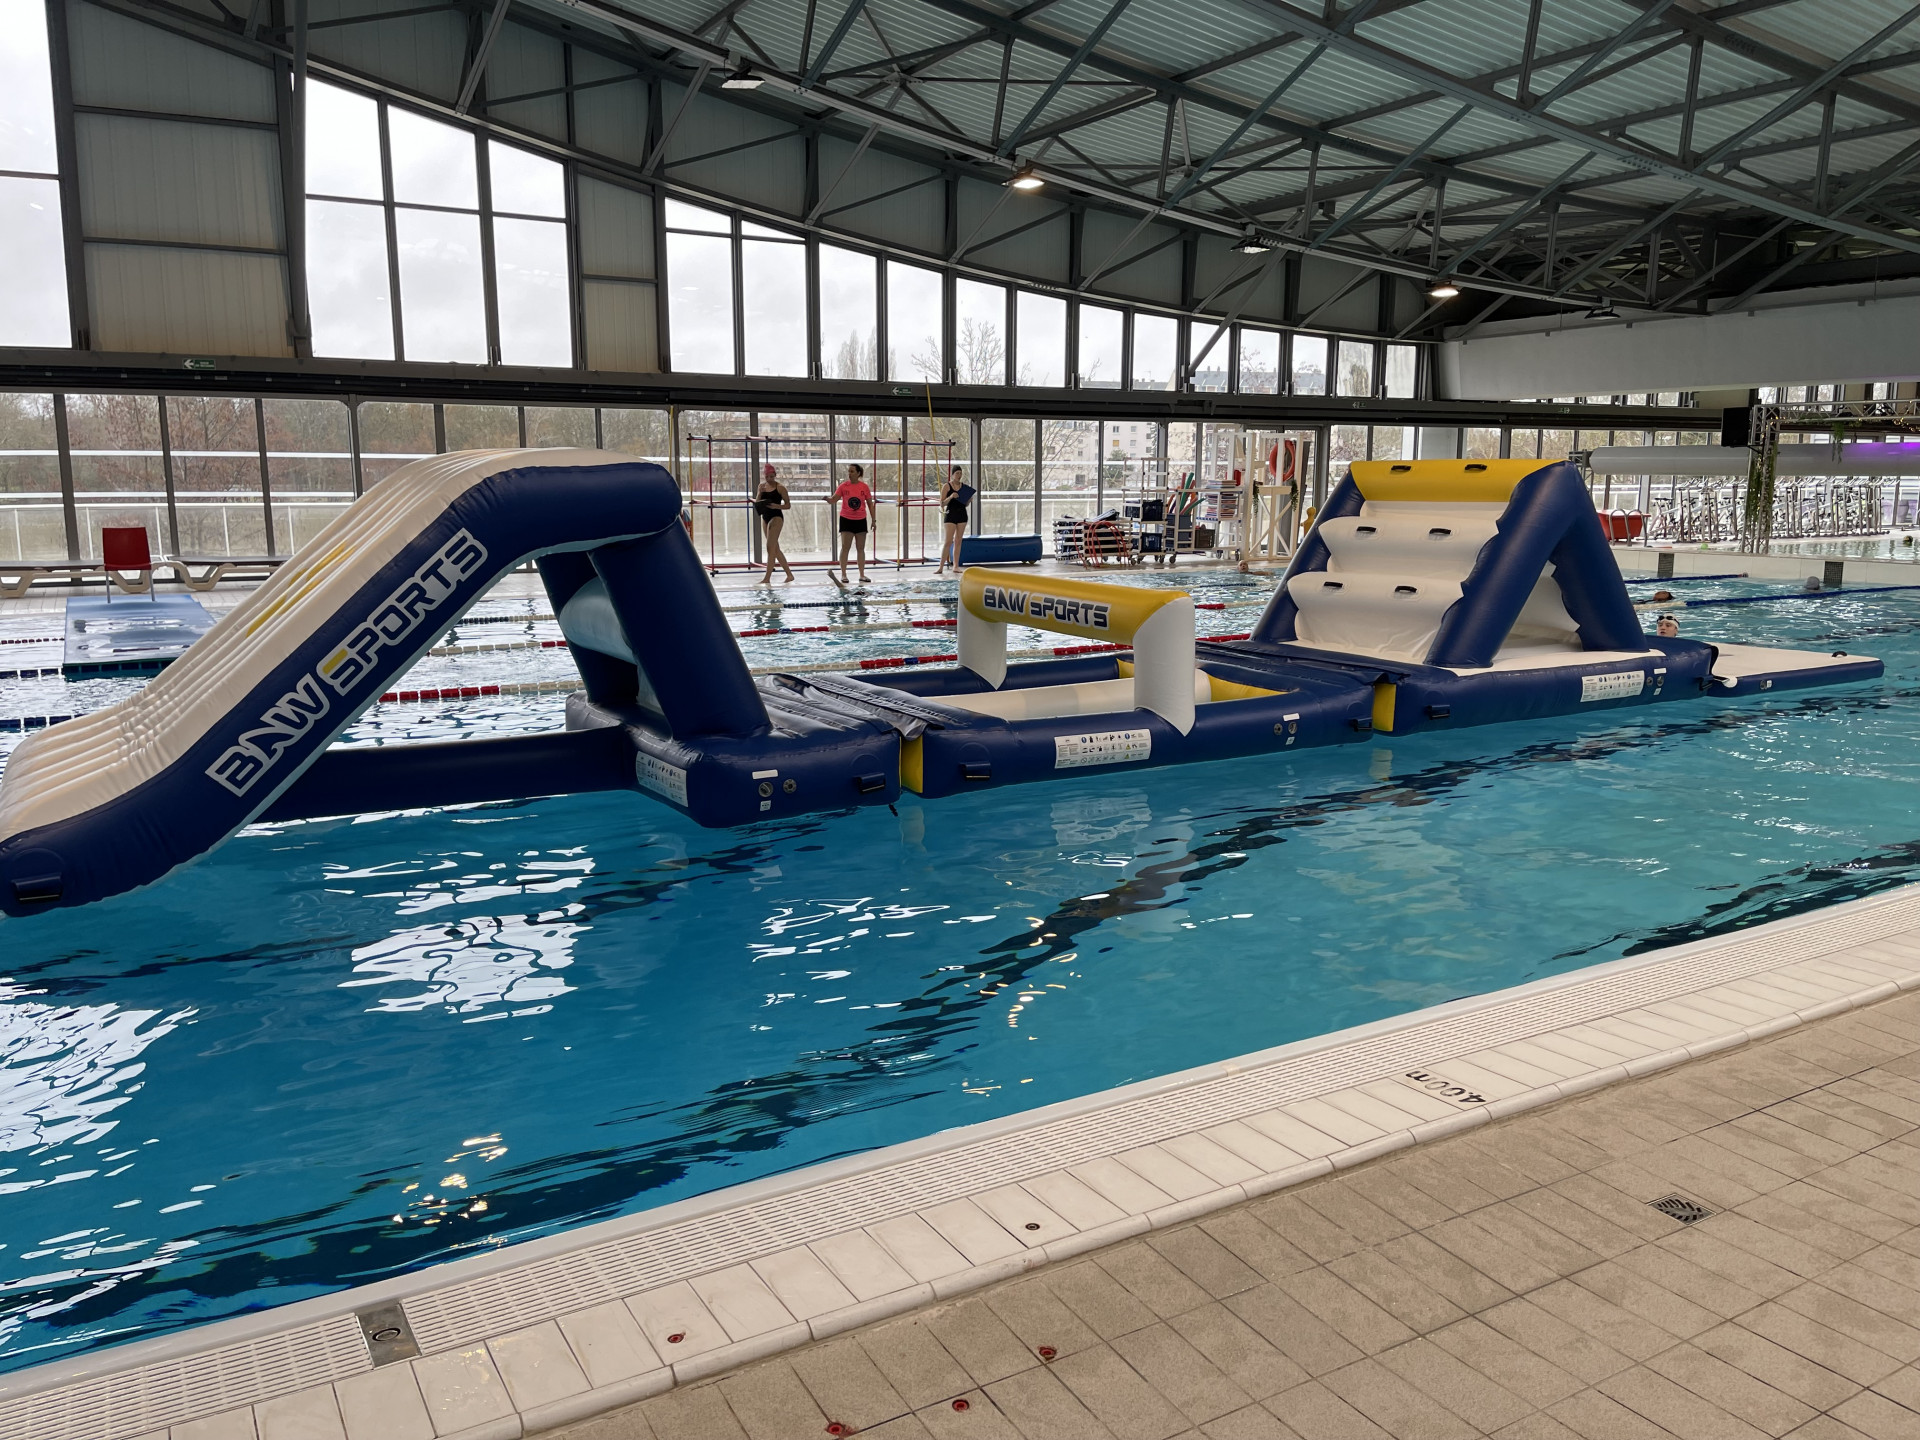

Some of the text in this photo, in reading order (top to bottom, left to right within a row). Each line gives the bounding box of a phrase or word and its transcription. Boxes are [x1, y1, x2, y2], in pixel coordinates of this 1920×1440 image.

[206, 528, 488, 796] BAW SPORTS
[984, 586, 1110, 629] BAW SPORTS
